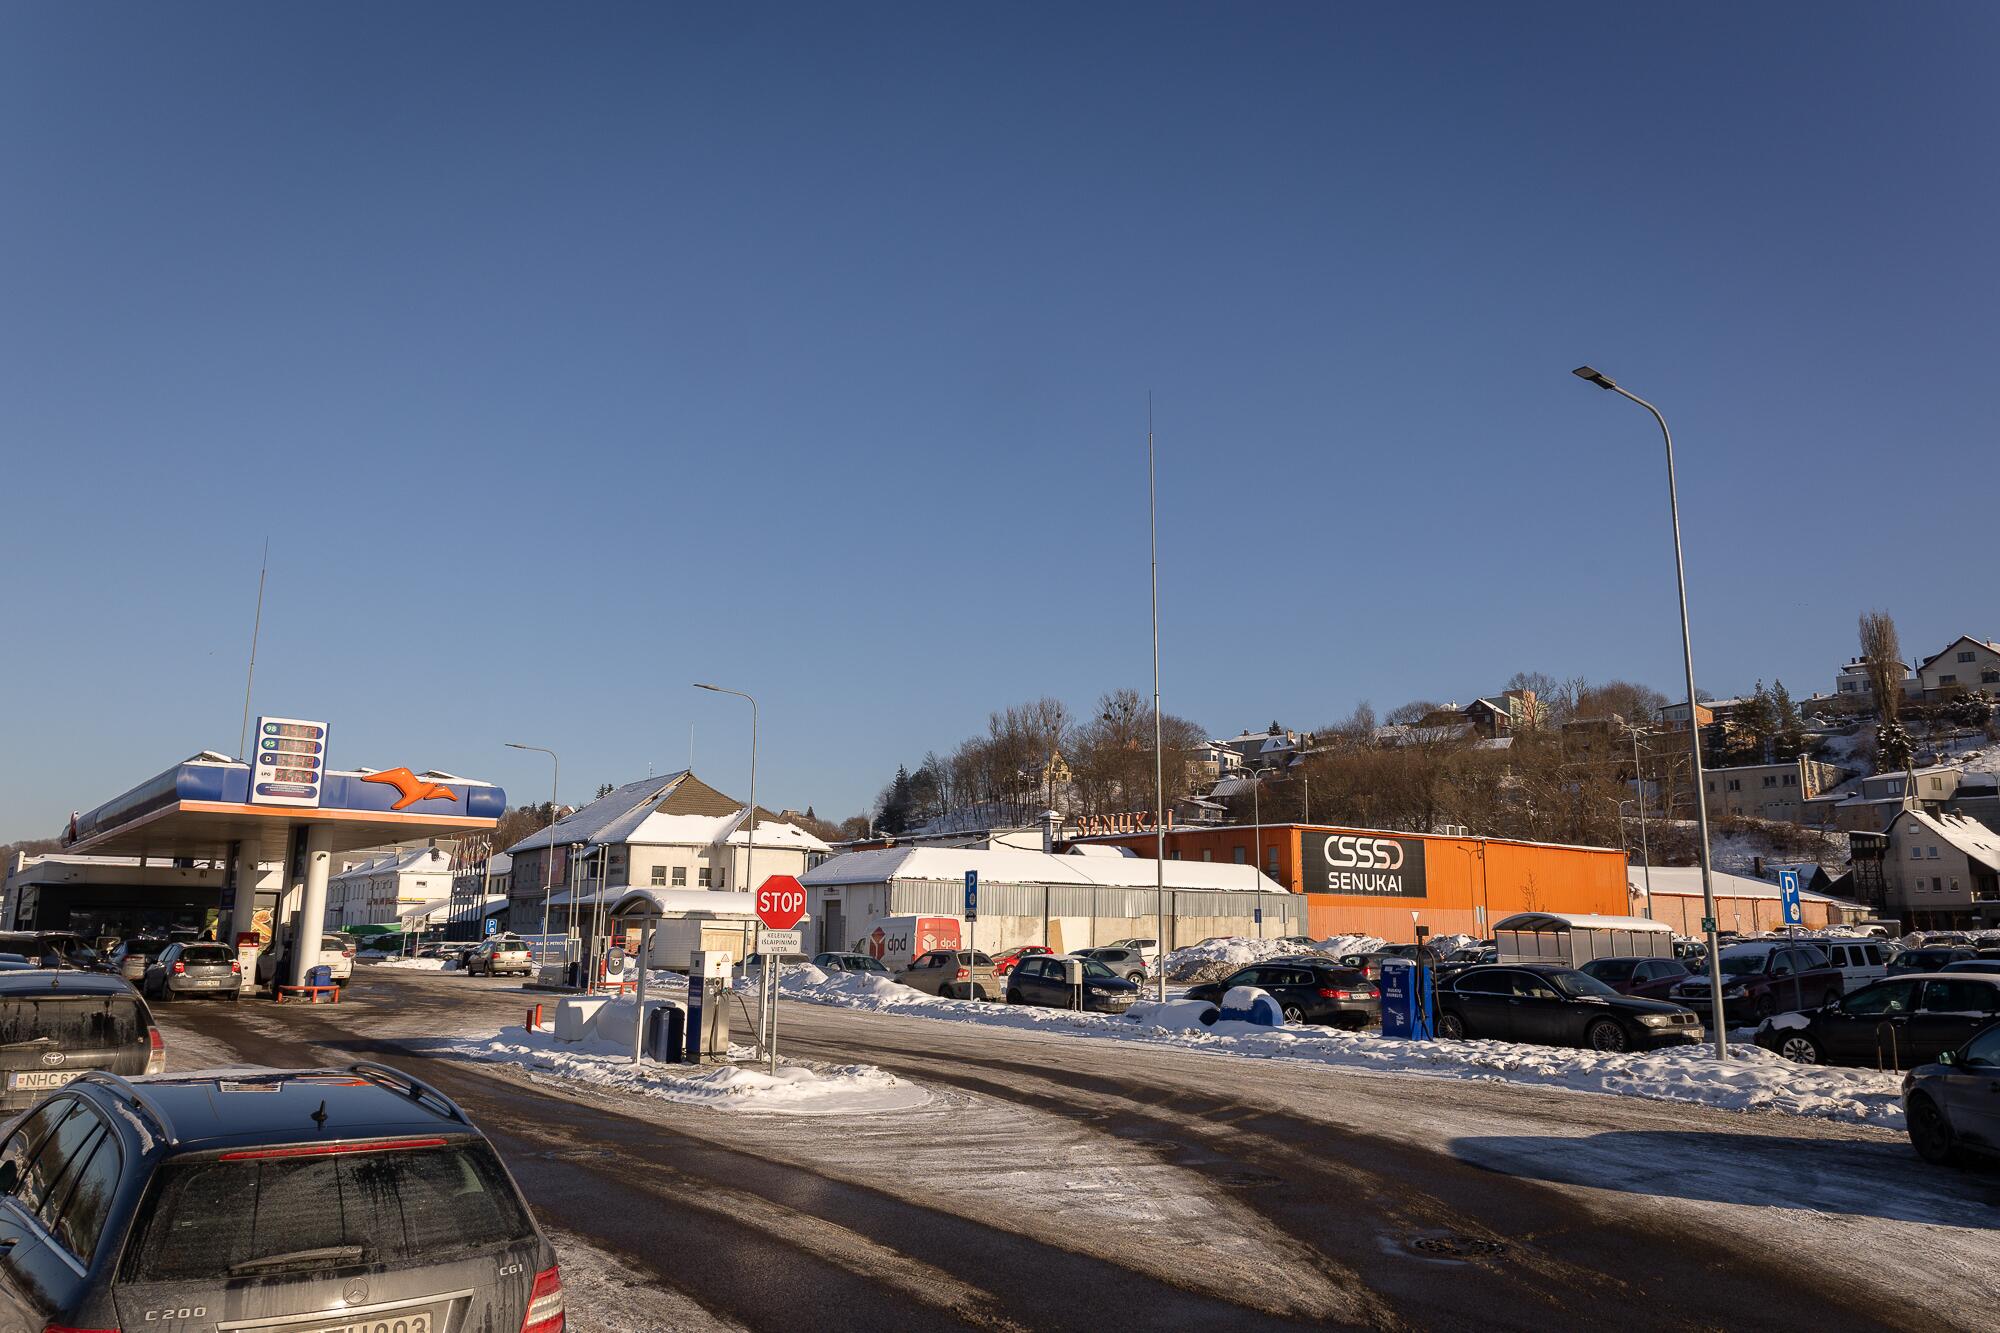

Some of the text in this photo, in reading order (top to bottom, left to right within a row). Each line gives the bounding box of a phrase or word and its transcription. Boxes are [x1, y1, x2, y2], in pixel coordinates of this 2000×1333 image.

[266, 725, 277, 733] 98
[968, 874, 975, 892] P
[1328, 872, 1402, 892] SENUKAI
[1785, 876, 1795, 902] P
[760, 891, 803, 913] STOP
[488, 920, 495, 928] P
[761, 938, 798, 946] IŠLAIPINIMO
[767, 932, 793, 940] KELEIVIŲ
[887, 933, 907, 955] dpd
[940, 937, 957, 949] dpd
[26, 1073, 58, 1086] NHC
[500, 1264, 523, 1275] CGI
[144, 1307, 207, 1321] C 200
